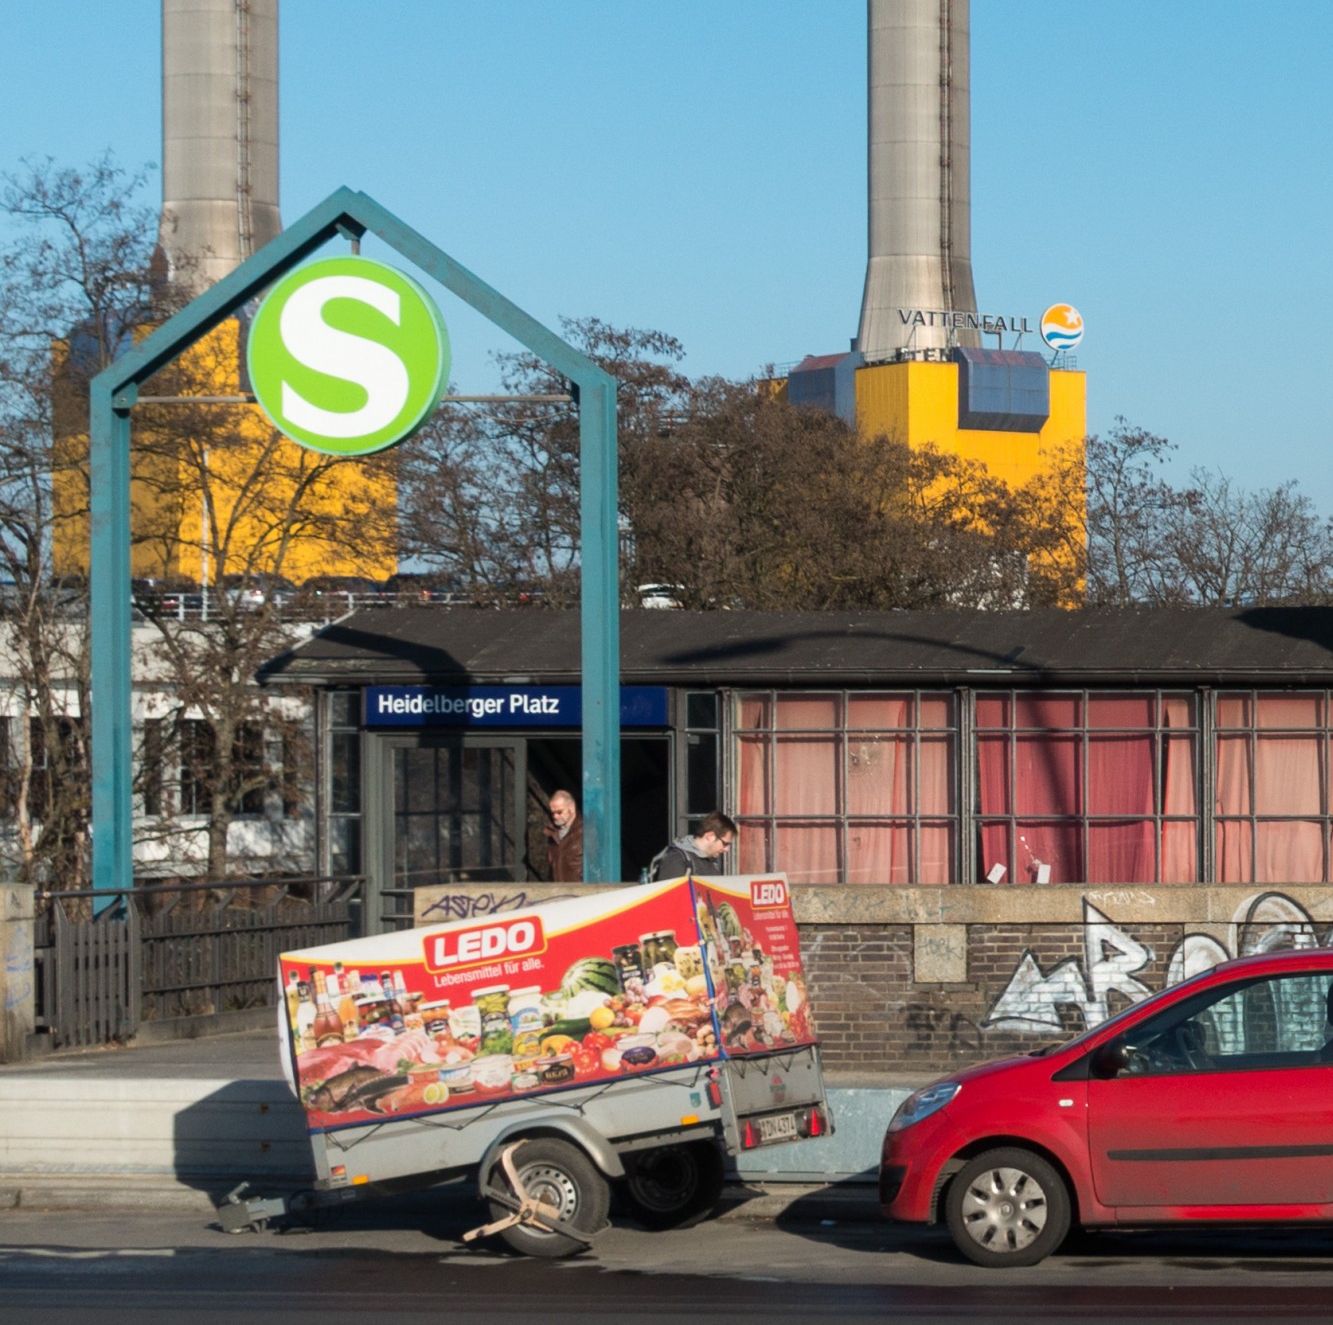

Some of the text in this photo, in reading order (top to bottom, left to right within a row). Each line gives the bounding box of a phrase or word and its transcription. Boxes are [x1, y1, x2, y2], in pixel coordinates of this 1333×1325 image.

[898, 308, 1033, 333] VATTENFALL
[279, 275, 409, 438] S
[378, 694, 559, 718] Heidelberger Platz
[753, 883, 785, 905] LEDO
[434, 921, 535, 966] LEDO
[433, 965, 502, 988] Lebensmittel
[504, 960, 519, 975] für
